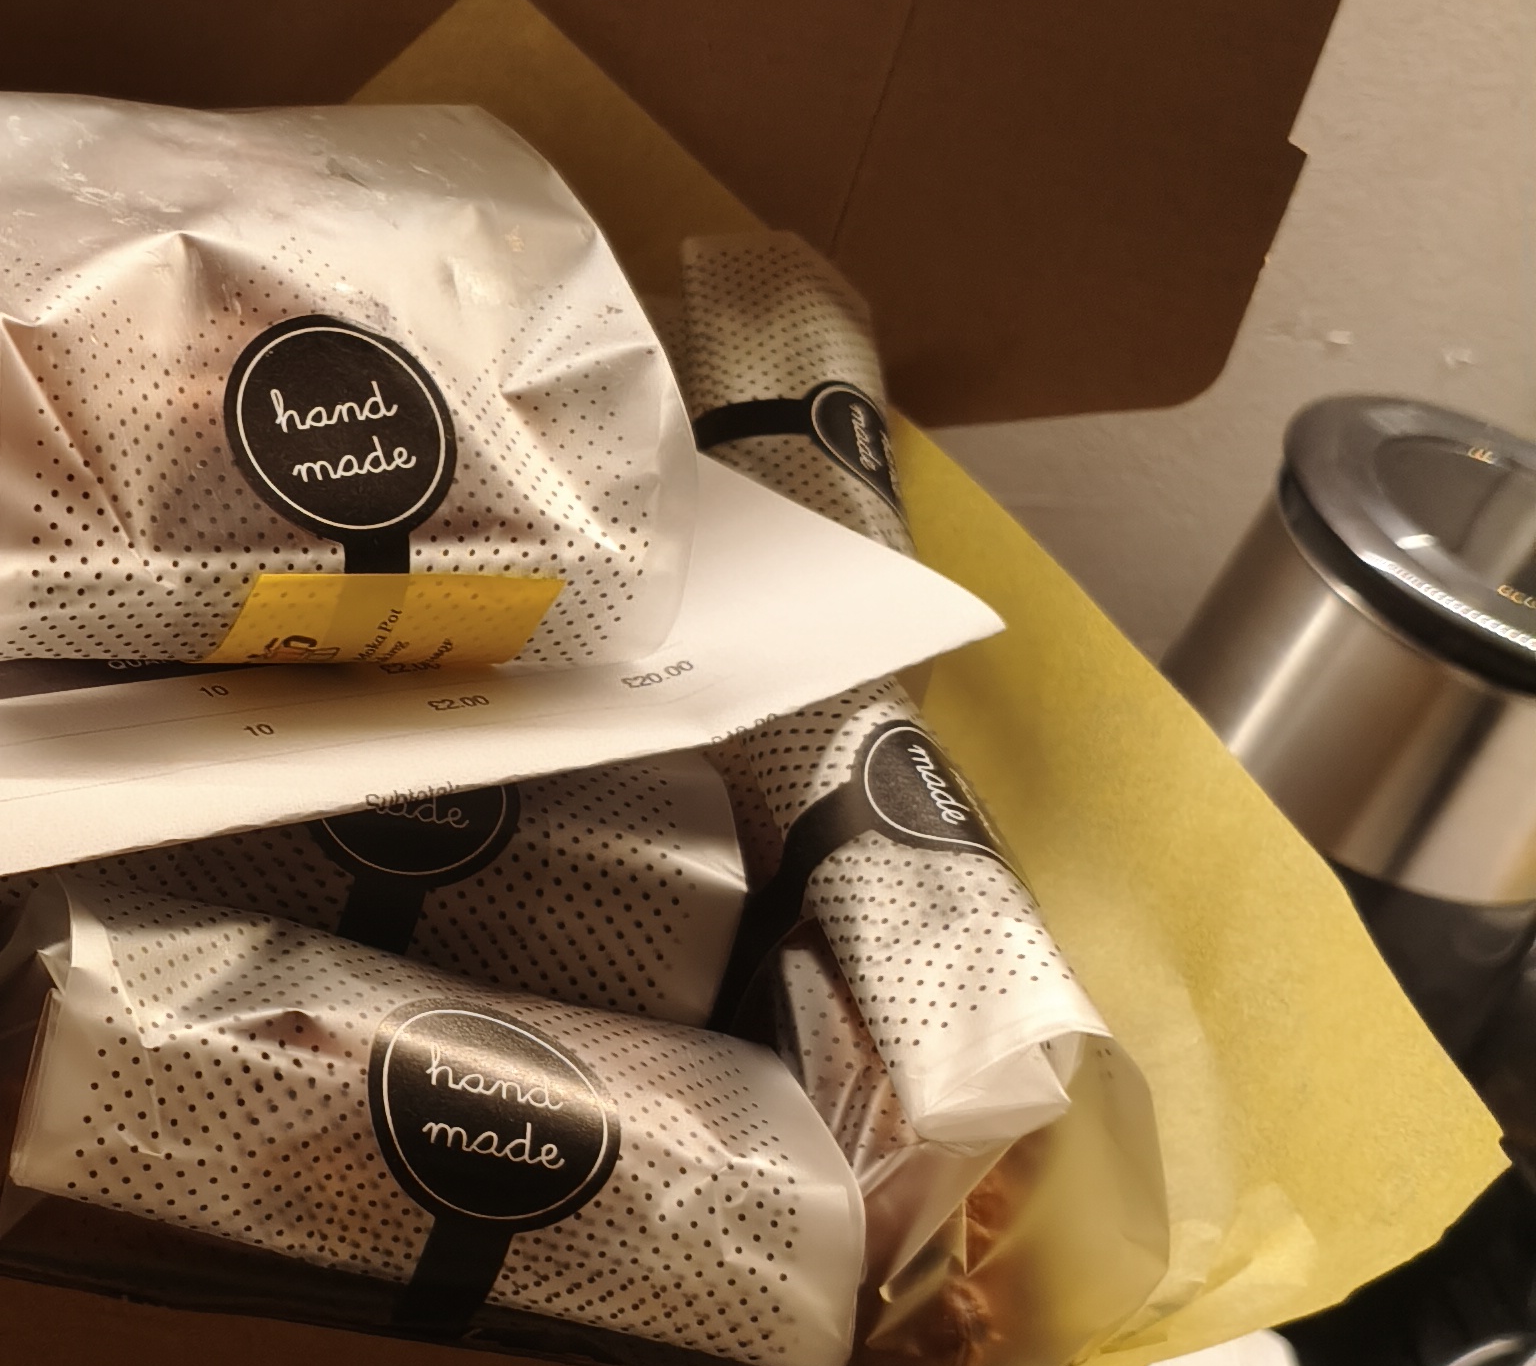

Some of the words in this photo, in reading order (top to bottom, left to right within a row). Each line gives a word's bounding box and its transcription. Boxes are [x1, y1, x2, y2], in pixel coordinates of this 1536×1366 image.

[269, 380, 399, 434] hand
[291, 434, 417, 483] made
[377, 608, 403, 633] Pot
[199, 685, 229, 698] 10
[621, 660, 695, 689] £20.00
[244, 723, 275, 737] 10
[427, 694, 490, 712] £2.00
[906, 743, 971, 825] made
[425, 1041, 564, 1111] hand
[421, 1121, 566, 1170] made
